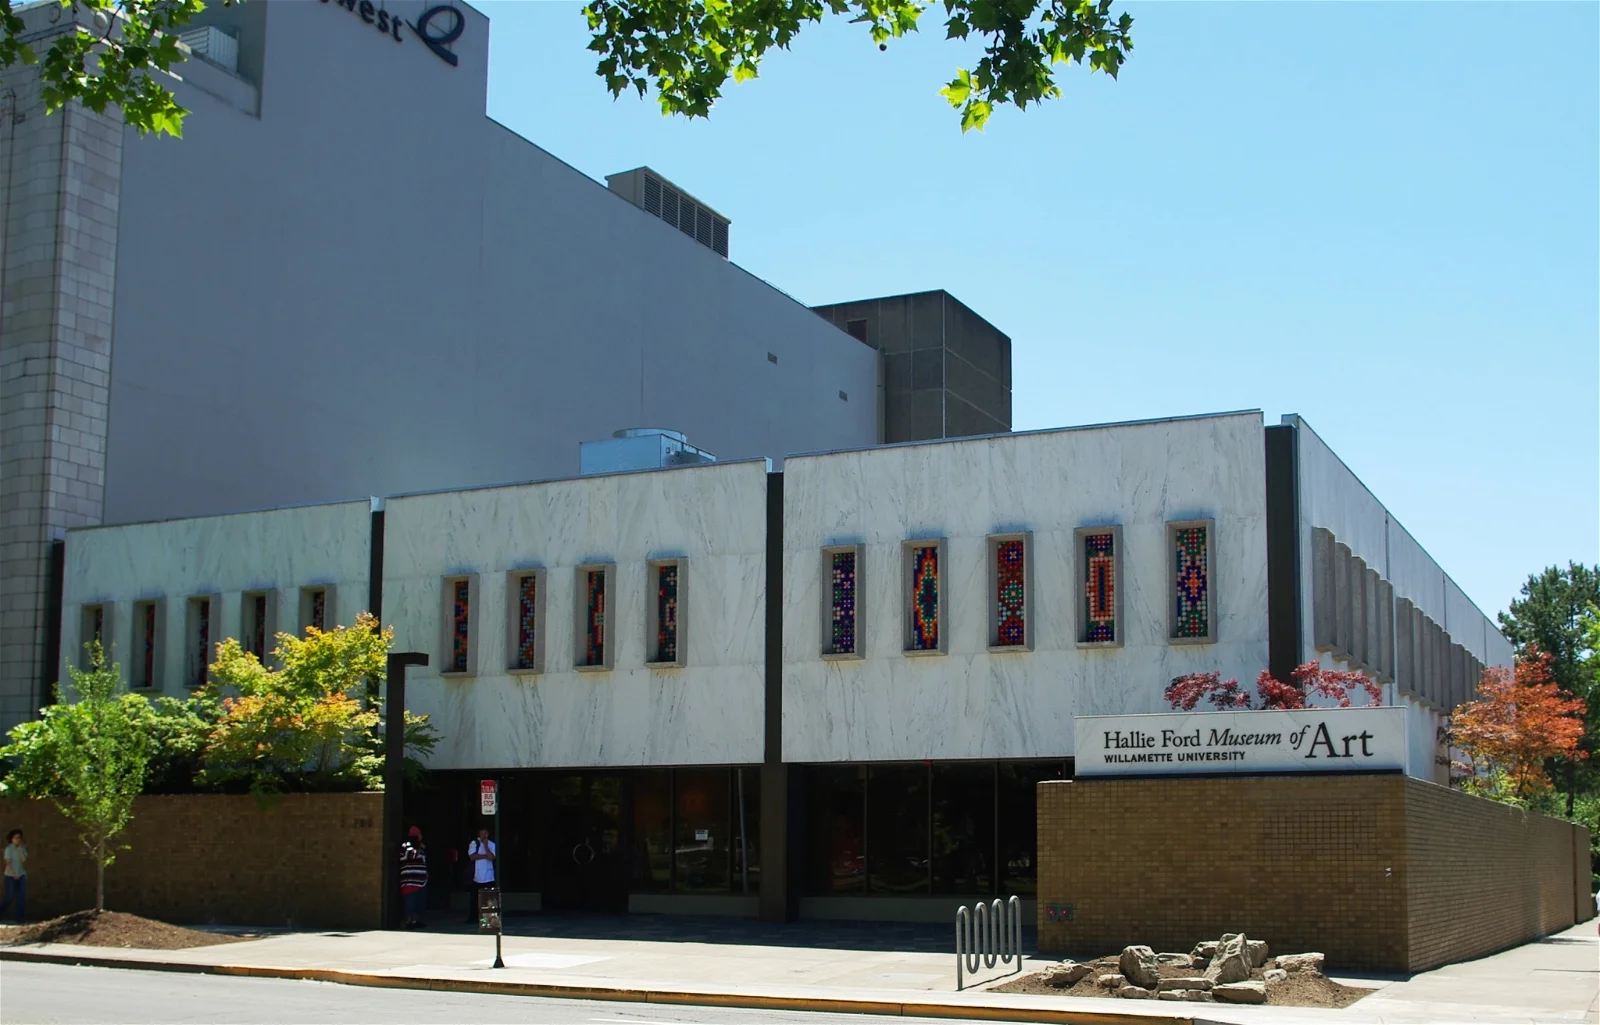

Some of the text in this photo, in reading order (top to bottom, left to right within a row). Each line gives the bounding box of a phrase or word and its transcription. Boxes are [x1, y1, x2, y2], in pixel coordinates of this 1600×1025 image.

[1104, 721, 1374, 759] Hallie Ford Museum of Art
[1104, 751, 1246, 763] WILLAMETTE UNIVERSITY
